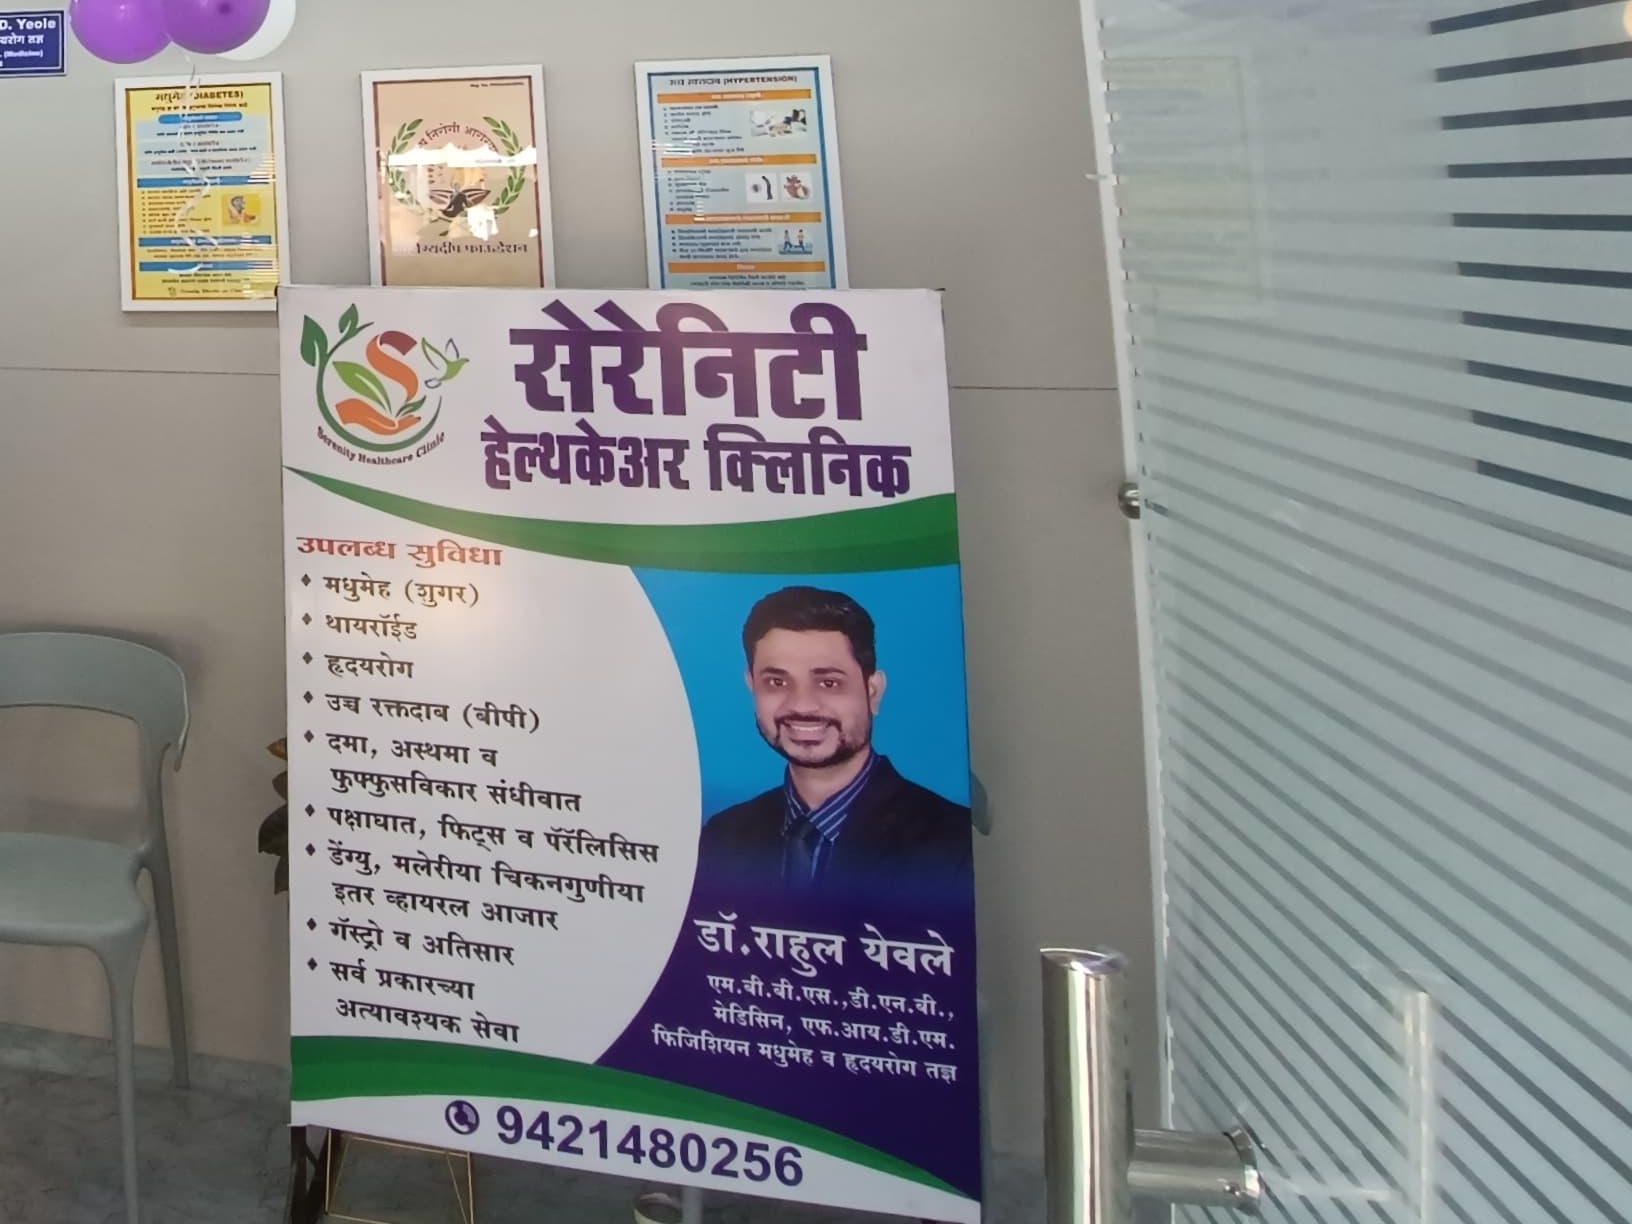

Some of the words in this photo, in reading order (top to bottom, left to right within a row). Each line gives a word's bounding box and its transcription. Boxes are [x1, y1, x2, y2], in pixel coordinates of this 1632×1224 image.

[16, 17, 57, 30] Yeole
[509, 299, 869, 421] सेरेनिटी
[480, 415, 690, 491] हेल्थकेअर
[704, 422, 912, 498] क्लिनिक
[296, 536, 396, 559] उपलब्ध
[406, 538, 503, 568] सुविधा
[323, 571, 391, 602] मधुमेह
[404, 579, 480, 608] (शुगर)
[325, 613, 418, 640] थायरॉईड
[324, 652, 414, 679] हृदयरोग
[324, 693, 361, 714] उच्च
[369, 697, 450, 723] रक्तदाब
[462, 701, 540, 734] (बीपी)
[325, 732, 377, 759] दमा,
[390, 739, 470, 765] अस्थमा
[478, 747, 498, 767] व
[329, 768, 478, 802] फुफ्फुसविकार
[486, 778, 583, 813] संधीवात
[326, 806, 427, 841] पक्षाघात,
[436, 813, 506, 853] फिट्स
[515, 828, 535, 849] व
[327, 838, 381, 876] डेंग्यु,
[391, 849, 482, 883] मलेरीया
[490, 859, 645, 904] चिकनगुणीया
[331, 882, 375, 906] इतर
[383, 888, 470, 918] व्हायरल
[480, 902, 560, 932] आजार
[328, 916, 384, 952] गॅस्ट्रो
[392, 930, 411, 951] व
[422, 931, 515, 966] अतिसार
[692, 910, 847, 977] डॉ.राहुल
[859, 922, 955, 977] येवले
[328, 958, 367, 985] सर्व
[375, 967, 476, 1001] प्रकारच्या
[336, 997, 462, 1034] अत्यावश्यक
[470, 1010, 520, 1044] सेवा
[712, 1000, 793, 1035] मेडिसिन,
[651, 1023, 751, 1058] फिजिशियन
[757, 1039, 814, 1068] मधुमेह
[821, 1049, 835, 1068] व
[842, 1050, 917, 1077] हृदयरोग
[924, 1061, 958, 1084] तज्ञ
[495, 1105, 805, 1188] 9421480256
